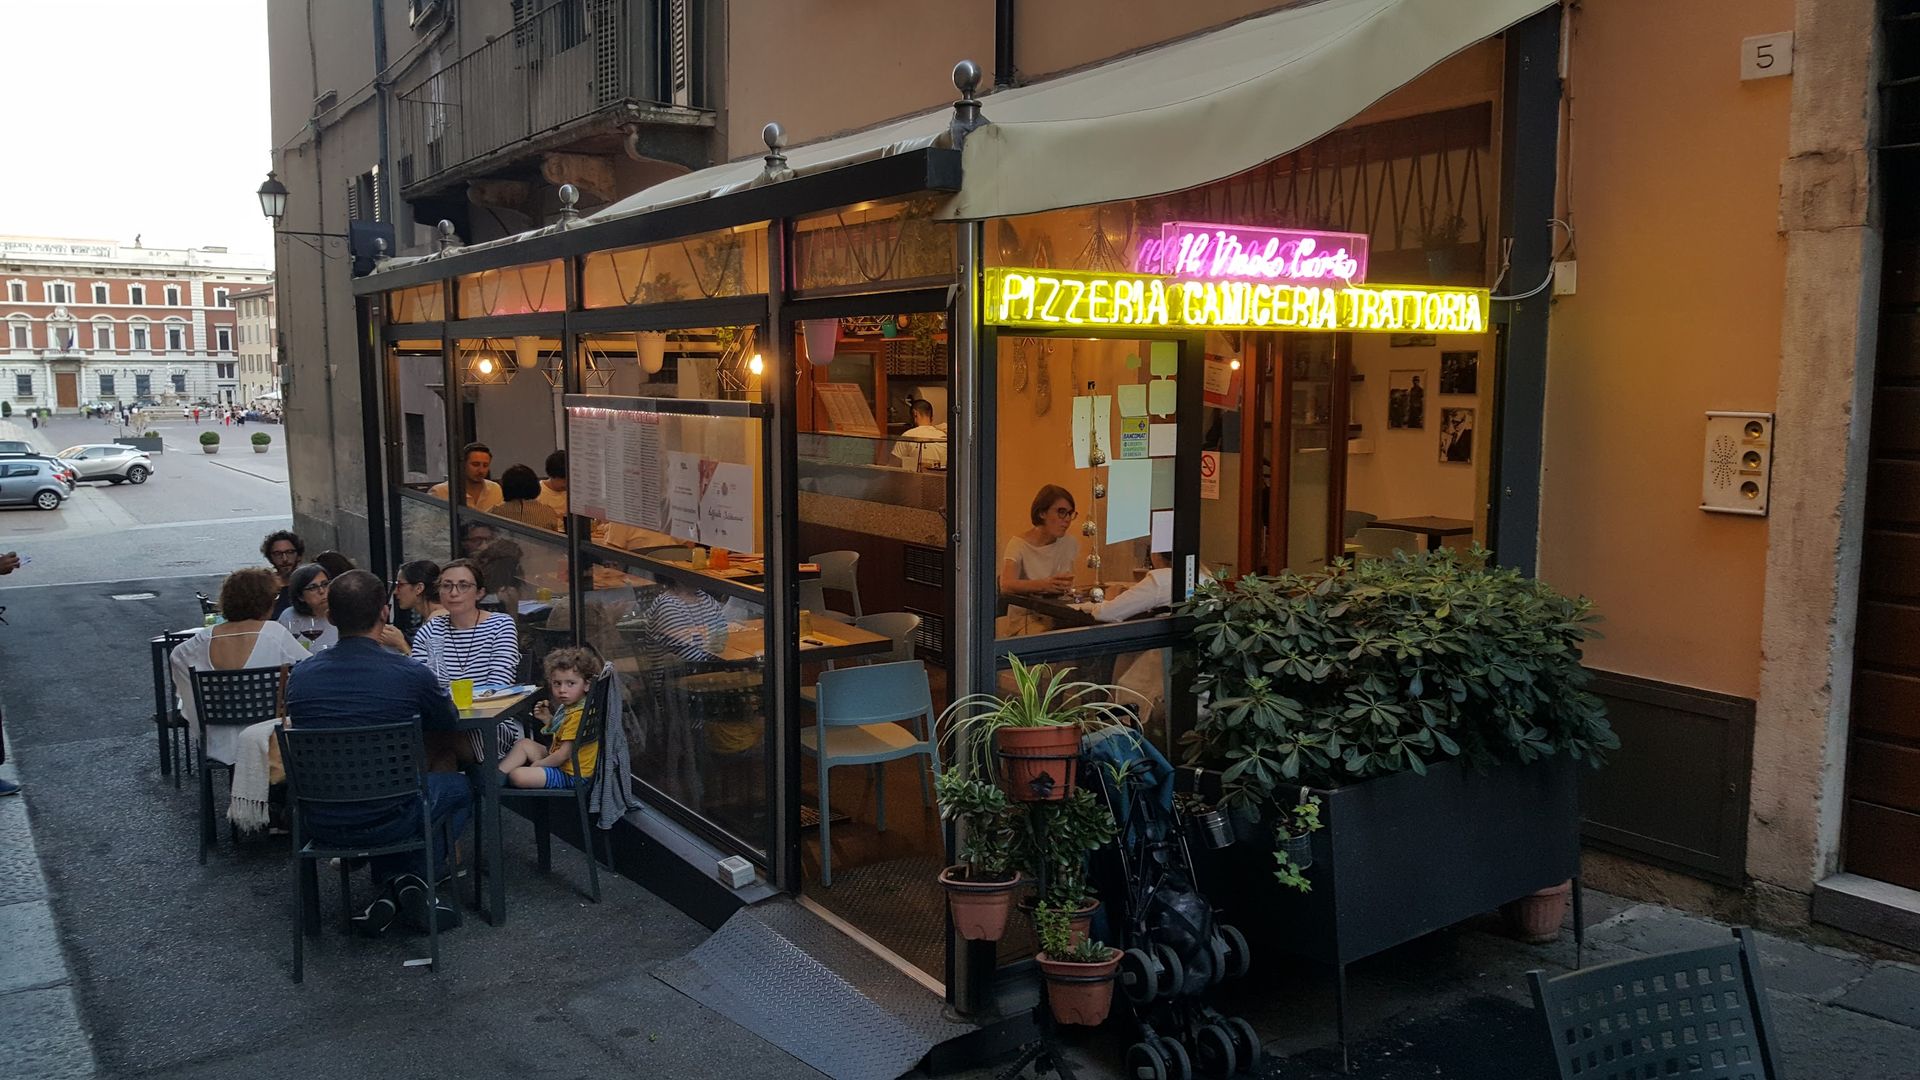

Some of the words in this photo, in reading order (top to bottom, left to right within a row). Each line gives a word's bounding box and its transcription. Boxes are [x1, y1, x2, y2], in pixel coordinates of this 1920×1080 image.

[1756, 44, 1774, 68] 5
[1176, 232, 1209, 274] Il
[1290, 238, 1357, 278] Corto
[1000, 275, 1168, 325] PIZZERIA
[1341, 288, 1482, 332] TRATTORIA
